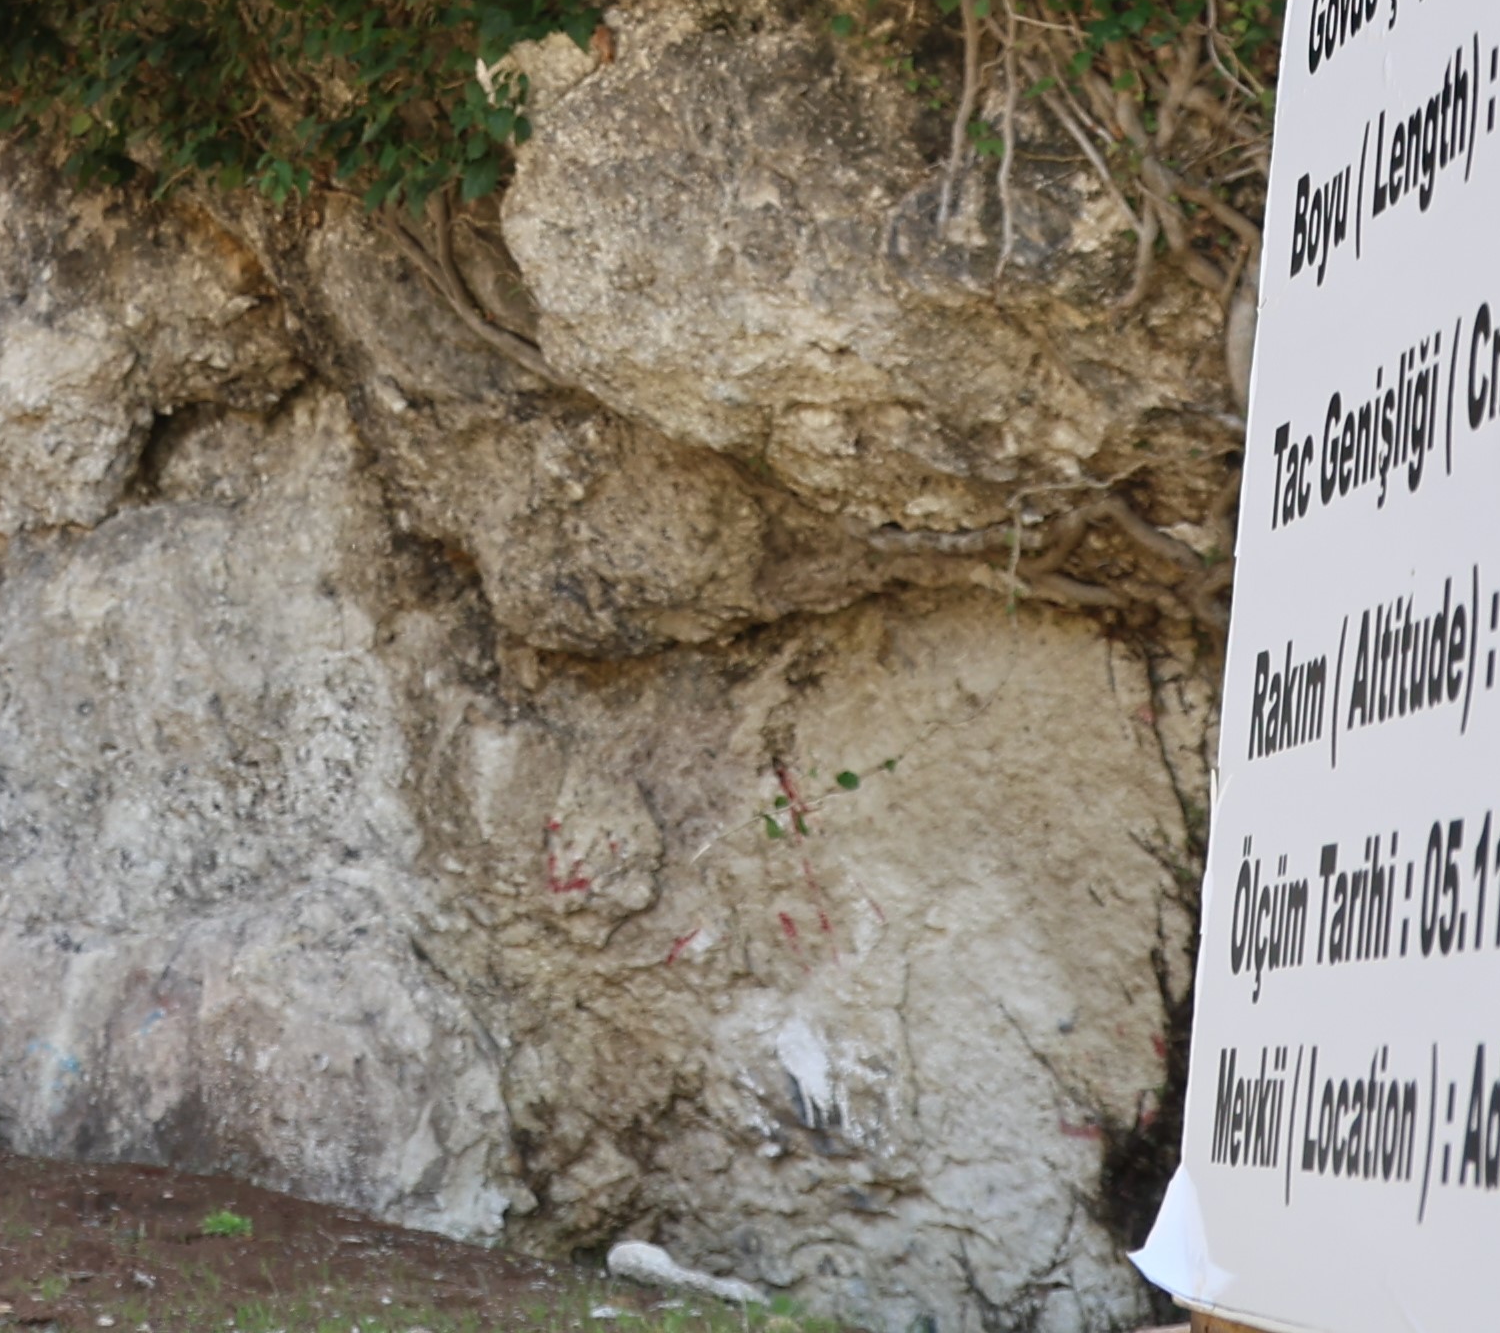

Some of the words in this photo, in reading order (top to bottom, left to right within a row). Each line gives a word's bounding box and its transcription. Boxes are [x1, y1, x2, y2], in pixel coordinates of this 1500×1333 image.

[1290, 163, 1352, 288] Boyu
[1372, 31, 1480, 219] Length)
[1271, 420, 1314, 532] Tac
[1320, 328, 1442, 510] Genişliği
[1247, 638, 1329, 762] Rakım
[1347, 561, 1480, 736] Altitude)
[1229, 835, 1309, 1005] Ölçüm
[1315, 827, 1398, 968] Tarihi
[1210, 1045, 1288, 1170] Mevkii
[1301, 1043, 1419, 1184] Location
